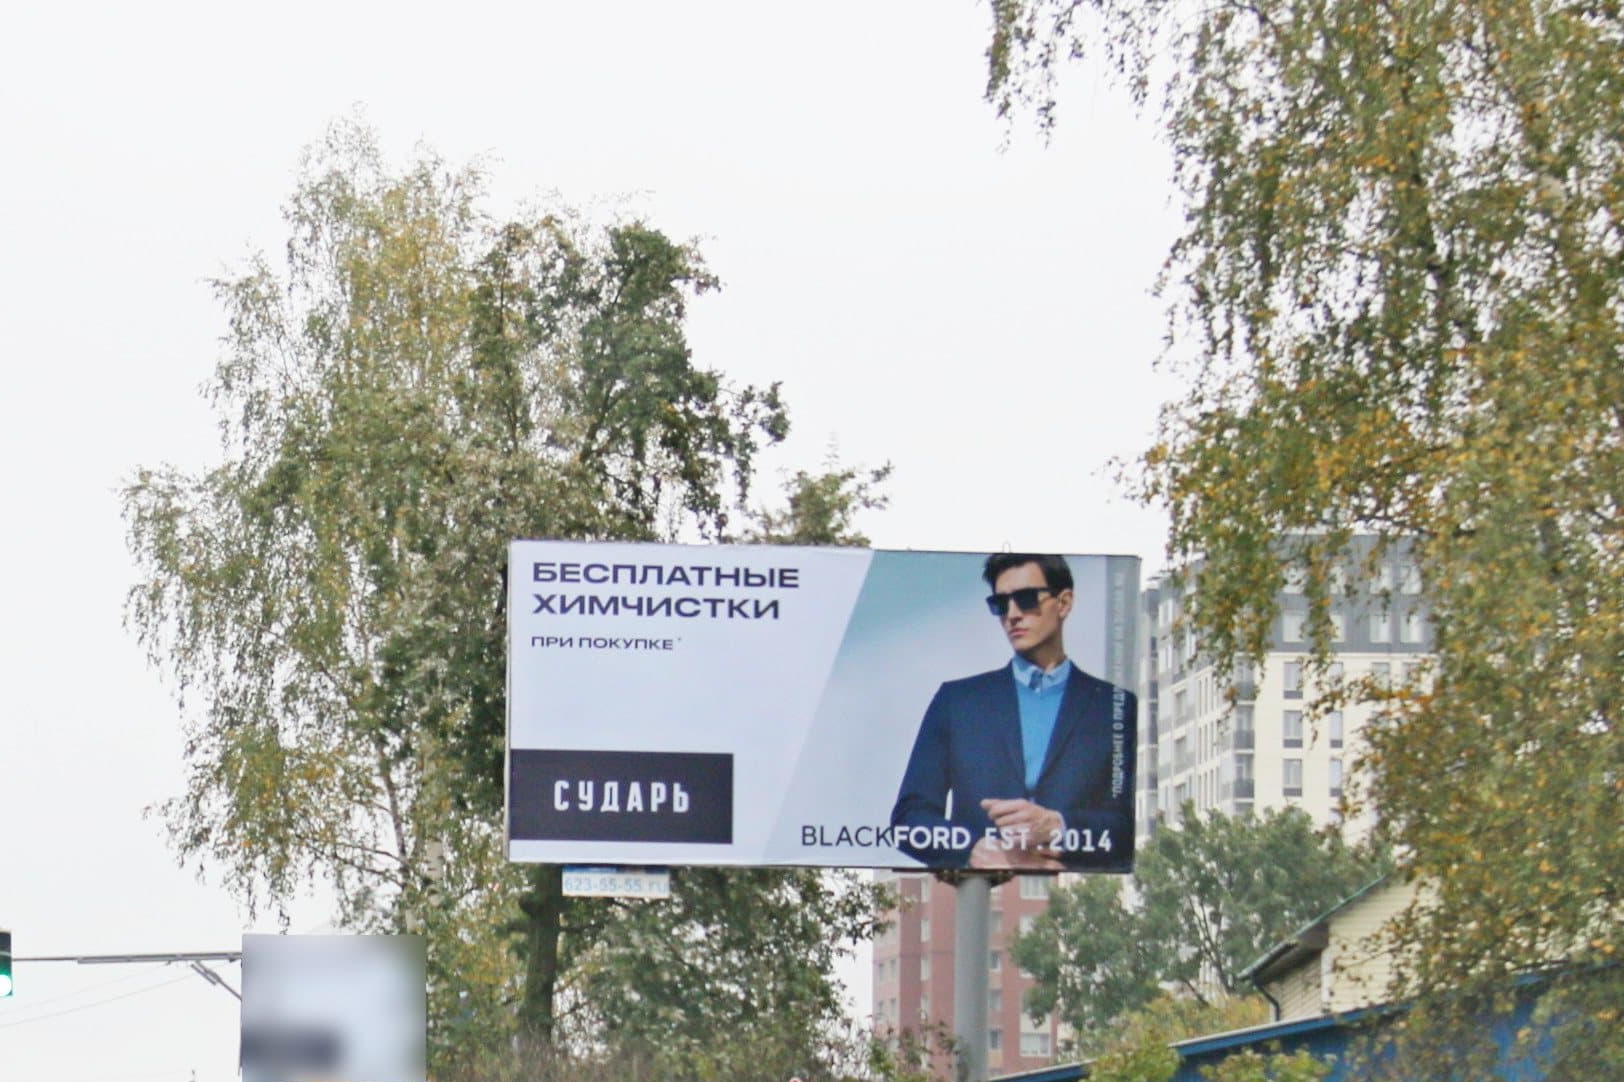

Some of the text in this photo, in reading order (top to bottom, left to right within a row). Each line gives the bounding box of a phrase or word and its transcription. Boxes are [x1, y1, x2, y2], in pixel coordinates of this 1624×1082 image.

[532, 561, 800, 589] БЕСПЛАТНЫЕ
[531, 592, 781, 620] ХИМЧИСТКИ
[531, 635, 573, 648] ПРИ
[553, 779, 690, 813] СУДАРЬ
[801, 825, 971, 850] BLACKFORD
